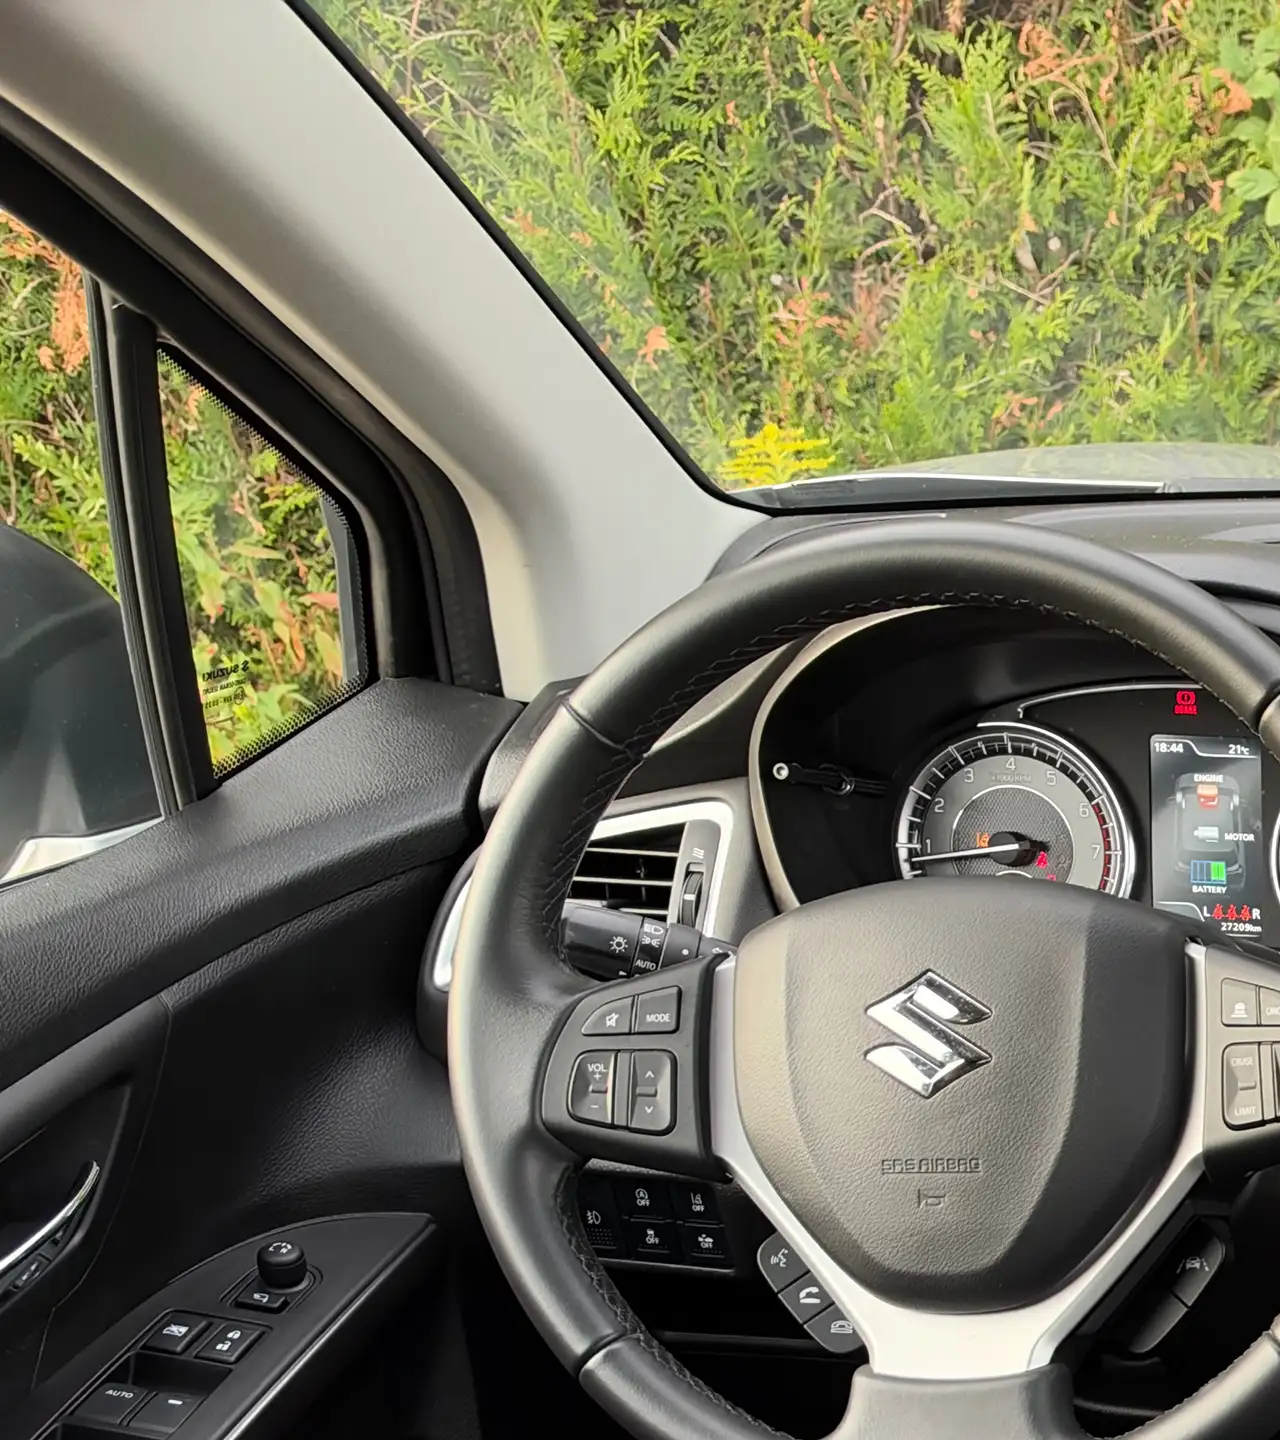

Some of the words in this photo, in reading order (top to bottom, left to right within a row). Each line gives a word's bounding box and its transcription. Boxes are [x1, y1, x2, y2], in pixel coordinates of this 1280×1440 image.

[1154, 742, 1184, 753] 18:44
[1005, 757, 1016, 771] 4
[964, 768, 974, 783] 3
[1046, 770, 1057, 785] 5
[1194, 774, 1224, 783] ENGINE
[934, 798, 945, 813] 2
[1079, 802, 1090, 818] 6
[1224, 833, 1255, 842] MOTOR
[1090, 844, 1101, 859] 7
[1192, 885, 1227, 894] BATTERY
[1203, 906, 1211, 917] L
[1252, 908, 1261, 920] R
[636, 958, 657, 971] AUTO
[646, 1012, 671, 1022] MODE
[587, 1063, 608, 1072] VOL
[1234, 1106, 1257, 1116] LIMIT
[646, 1237, 660, 1245] OFF
[105, 1389, 134, 1399] AUTO
